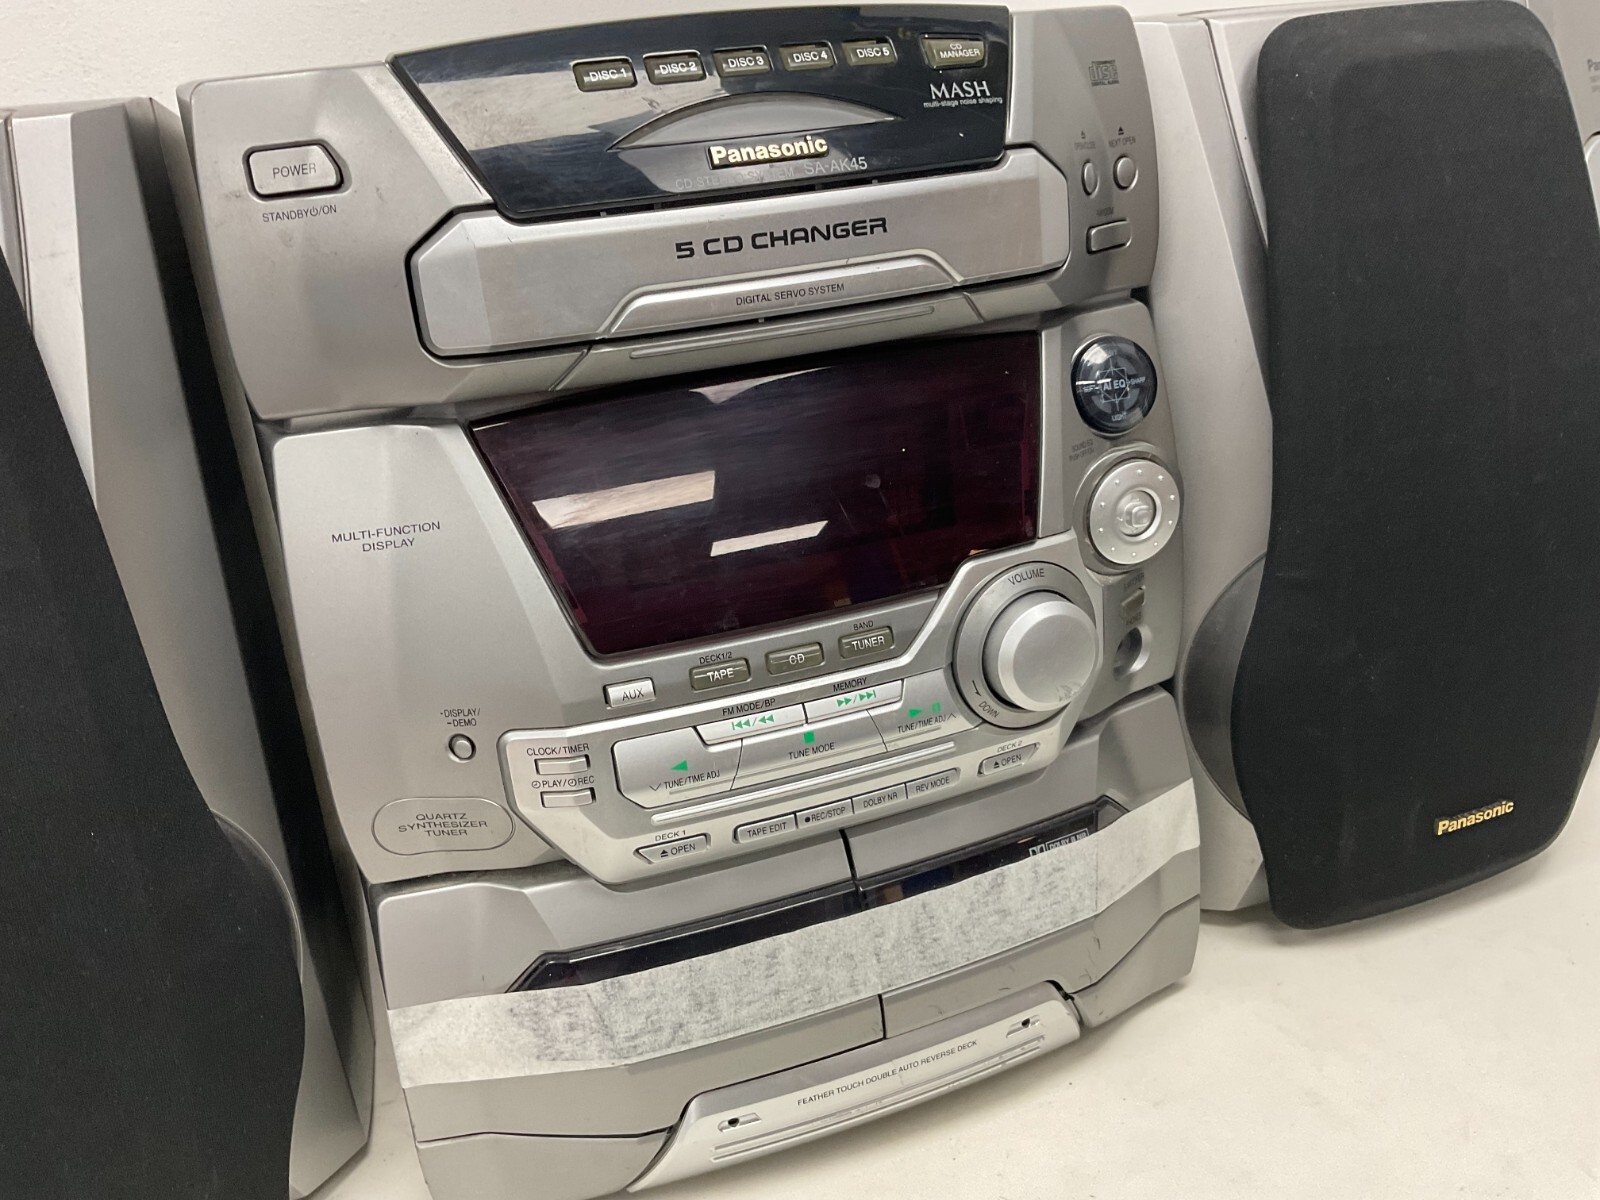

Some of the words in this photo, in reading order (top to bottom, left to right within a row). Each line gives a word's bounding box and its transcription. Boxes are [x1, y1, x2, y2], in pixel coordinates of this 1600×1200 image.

[793, 52, 819, 63] DISC
[820, 51, 828, 61] 4
[856, 48, 881, 59] DISC
[883, 47, 891, 56] 5
[940, 48, 981, 58] MANAGER
[660, 63, 684, 75] DISC
[687, 61, 698, 72] 2
[728, 57, 753, 69] DISC
[755, 56, 764, 66] 3
[590, 69, 621, 82] DISC
[622, 68, 628, 78] 1
[929, 80, 991, 100] MASH
[923, 99, 959, 108] multi-stage
[978, 96, 1003, 104] shaping
[709, 135, 829, 166] Panasonic
[272, 163, 317, 179] POWER
[804, 156, 868, 175] SA-AK45
[675, 241, 695, 259] 5
[703, 235, 744, 256] CD
[751, 217, 888, 250] CHANGER
[736, 293, 772, 306] DIGITAL
[774, 288, 806, 301] SERVO
[808, 283, 845, 296] SYSTEM
[1114, 379, 1126, 389] EQ
[331, 521, 441, 543] MULTI-FUNCTION
[362, 538, 415, 552] DISPLAY
[1008, 568, 1045, 586] VOLUME
[853, 620, 874, 631] BAND
[851, 635, 886, 651] TUNER
[699, 651, 733, 665] DECK1/2
[789, 653, 805, 665] CD
[707, 668, 734, 682] TAPE
[832, 677, 868, 692] MEMORY
[622, 687, 645, 701] AUX
[722, 706, 735, 717] FM
[736, 698, 776, 714] MODE/BP
[978, 700, 1000, 719] DOWN
[898, 717, 933, 734] TUNE/TIME
[934, 714, 947, 725] ADJ
[788, 749, 810, 760] TUNE
[811, 742, 835, 754] MODE
[997, 742, 1016, 753] DECK
[1017, 739, 1023, 747] 2
[1001, 754, 1022, 767] OPEN
[664, 773, 705, 789] TUNE/TIME
[706, 769, 720, 780] ADJ
[915, 781, 929, 793] REV
[930, 776, 950, 789] MODE
[863, 795, 886, 808] DOLBY
[887, 792, 898, 803] NR
[415, 812, 468, 821] QUARTZ
[811, 806, 846, 823] REC/STOP
[1437, 800, 1515, 836] Panasonic
[398, 820, 488, 833] SYNTHESIZER
[424, 829, 468, 837] TUNER
[747, 826, 767, 838] TAPE
[769, 821, 787, 833] EDIT
[655, 831, 680, 842] DECK
[670, 843, 696, 856] OPEN
[797, 1089, 835, 1106] FEATHER
[836, 1080, 864, 1095] TOUCH
[866, 1069, 897, 1085] DOUBLE
[898, 1060, 919, 1073] AUTO
[920, 1047, 956, 1065] REVERSE
[957, 1039, 977, 1052] DECK
